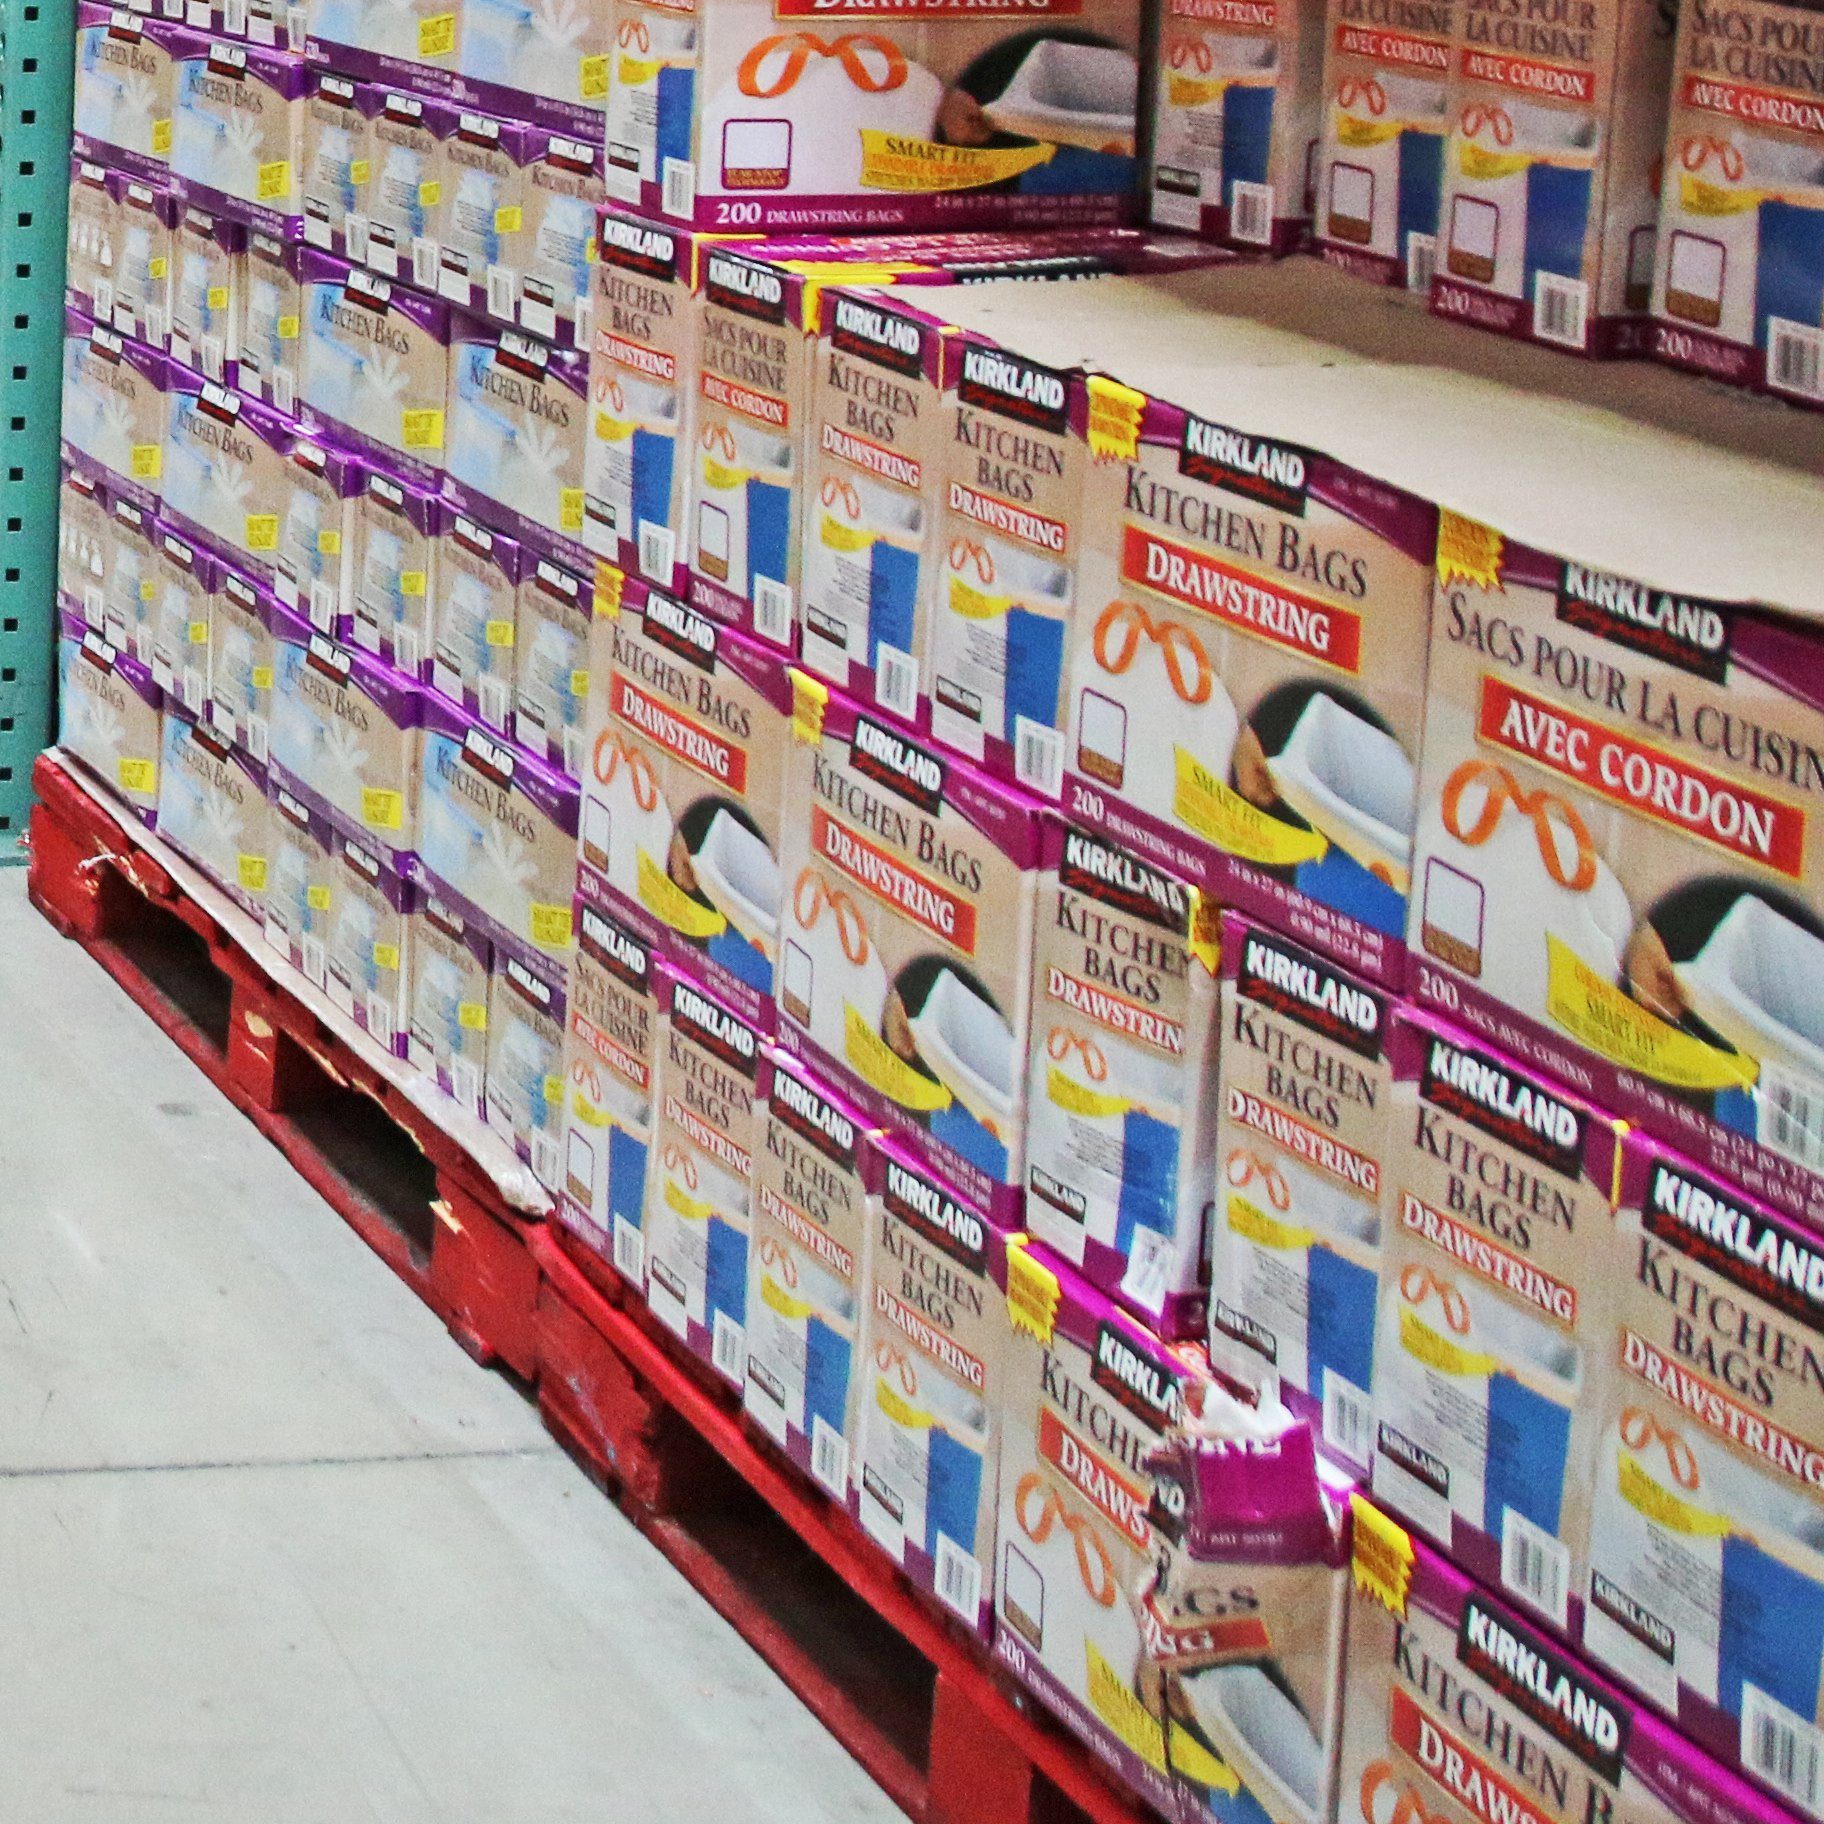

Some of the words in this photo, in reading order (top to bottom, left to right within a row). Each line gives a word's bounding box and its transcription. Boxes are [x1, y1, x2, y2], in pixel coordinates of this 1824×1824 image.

[1509, 63, 1587, 98] CORDON
[1727, 43, 1824, 95] CUISIN
[604, 216, 673, 260] KIRKLAND
[716, 203, 762, 224] 200
[598, 269, 673, 317] KITCHEN
[709, 257, 782, 303] KIRKLAND
[1436, 285, 1469, 315] 200
[612, 306, 653, 341] BAGS
[836, 298, 919, 352] KIRKLAND
[1656, 332, 1693, 361] 200
[527, 381, 570, 428] BAGS
[828, 354, 919, 417] KITCHEN
[964, 347, 1064, 410] KIRKLAND
[846, 399, 896, 442] BAGS
[954, 409, 1065, 476] KITCHEN
[1186, 420, 1305, 486] KIRKLAND
[822, 429, 919, 487] DRAWSTRING
[976, 456, 1034, 503] BAGS
[950, 481, 1064, 551] DRAWSTRING
[1125, 465, 1269, 556] KITCHEN
[1276, 523, 1368, 599] BAGS
[645, 591, 715, 651] KIRKLAND
[1146, 542, 1330, 652] DRAWSTRING
[1565, 563, 1724, 649] KIRKLAND
[611, 625, 692, 690] KITCHEN
[695, 673, 751, 738] BAGS
[1447, 593, 1525, 668] SACS
[1533, 634, 1629, 713] POUR
[1638, 680, 1684, 739] LA
[1694, 702, 1824, 794] CUISIN
[622, 688, 730, 778] DRAWSTRING
[855, 719, 942, 793] KIRKLAND
[1072, 786, 1105, 819] 200
[1501, 698, 1588, 770] AVEC
[1601, 737, 1776, 855] CORDON
[812, 752, 913, 842] KITCHEN
[917, 826, 983, 894] BAGS
[823, 821, 955, 936] DRAWSTRING
[1066, 832, 1185, 912] KIRKLAND
[581, 909, 646, 973] KIRKLAND
[1084, 946, 1161, 1005] BAGS
[674, 984, 754, 1058] KIRKLAND
[1048, 970, 1184, 1054] DRAWSTRIN
[1248, 941, 1378, 1032] KIRKLAND
[1419, 968, 1459, 1013] 200
[1234, 999, 1379, 1109] KITCHEN
[685, 1069, 732, 1132] BAGS
[774, 1070, 854, 1148] KIRKLAND
[1266, 1063, 1342, 1129] BAGS
[1431, 1039, 1578, 1148] KIRKLAND
[1229, 1090, 1379, 1192] DRAWSTRING
[1414, 1107, 1577, 1233] KITCHEN
[783, 1172, 831, 1226] BAGS
[887, 1162, 984, 1252] KIRKLAND
[1451, 1176, 1533, 1250] BAGS
[1654, 1166, 1824, 1295] KIRKLAND
[881, 1219, 984, 1318] KITCHEN
[1403, 1196, 1574, 1321] DRAWSTRING
[901, 1269, 956, 1330] BAGS
[876, 1288, 984, 1388] DRAWSTRING
[1671, 1314, 1776, 1409] BAGS
[1097, 1337, 1180, 1426] KIRKLA
[1059, 1434, 1150, 1534] DRAWS
[1468, 1606, 1619, 1750] KIRKLAND
